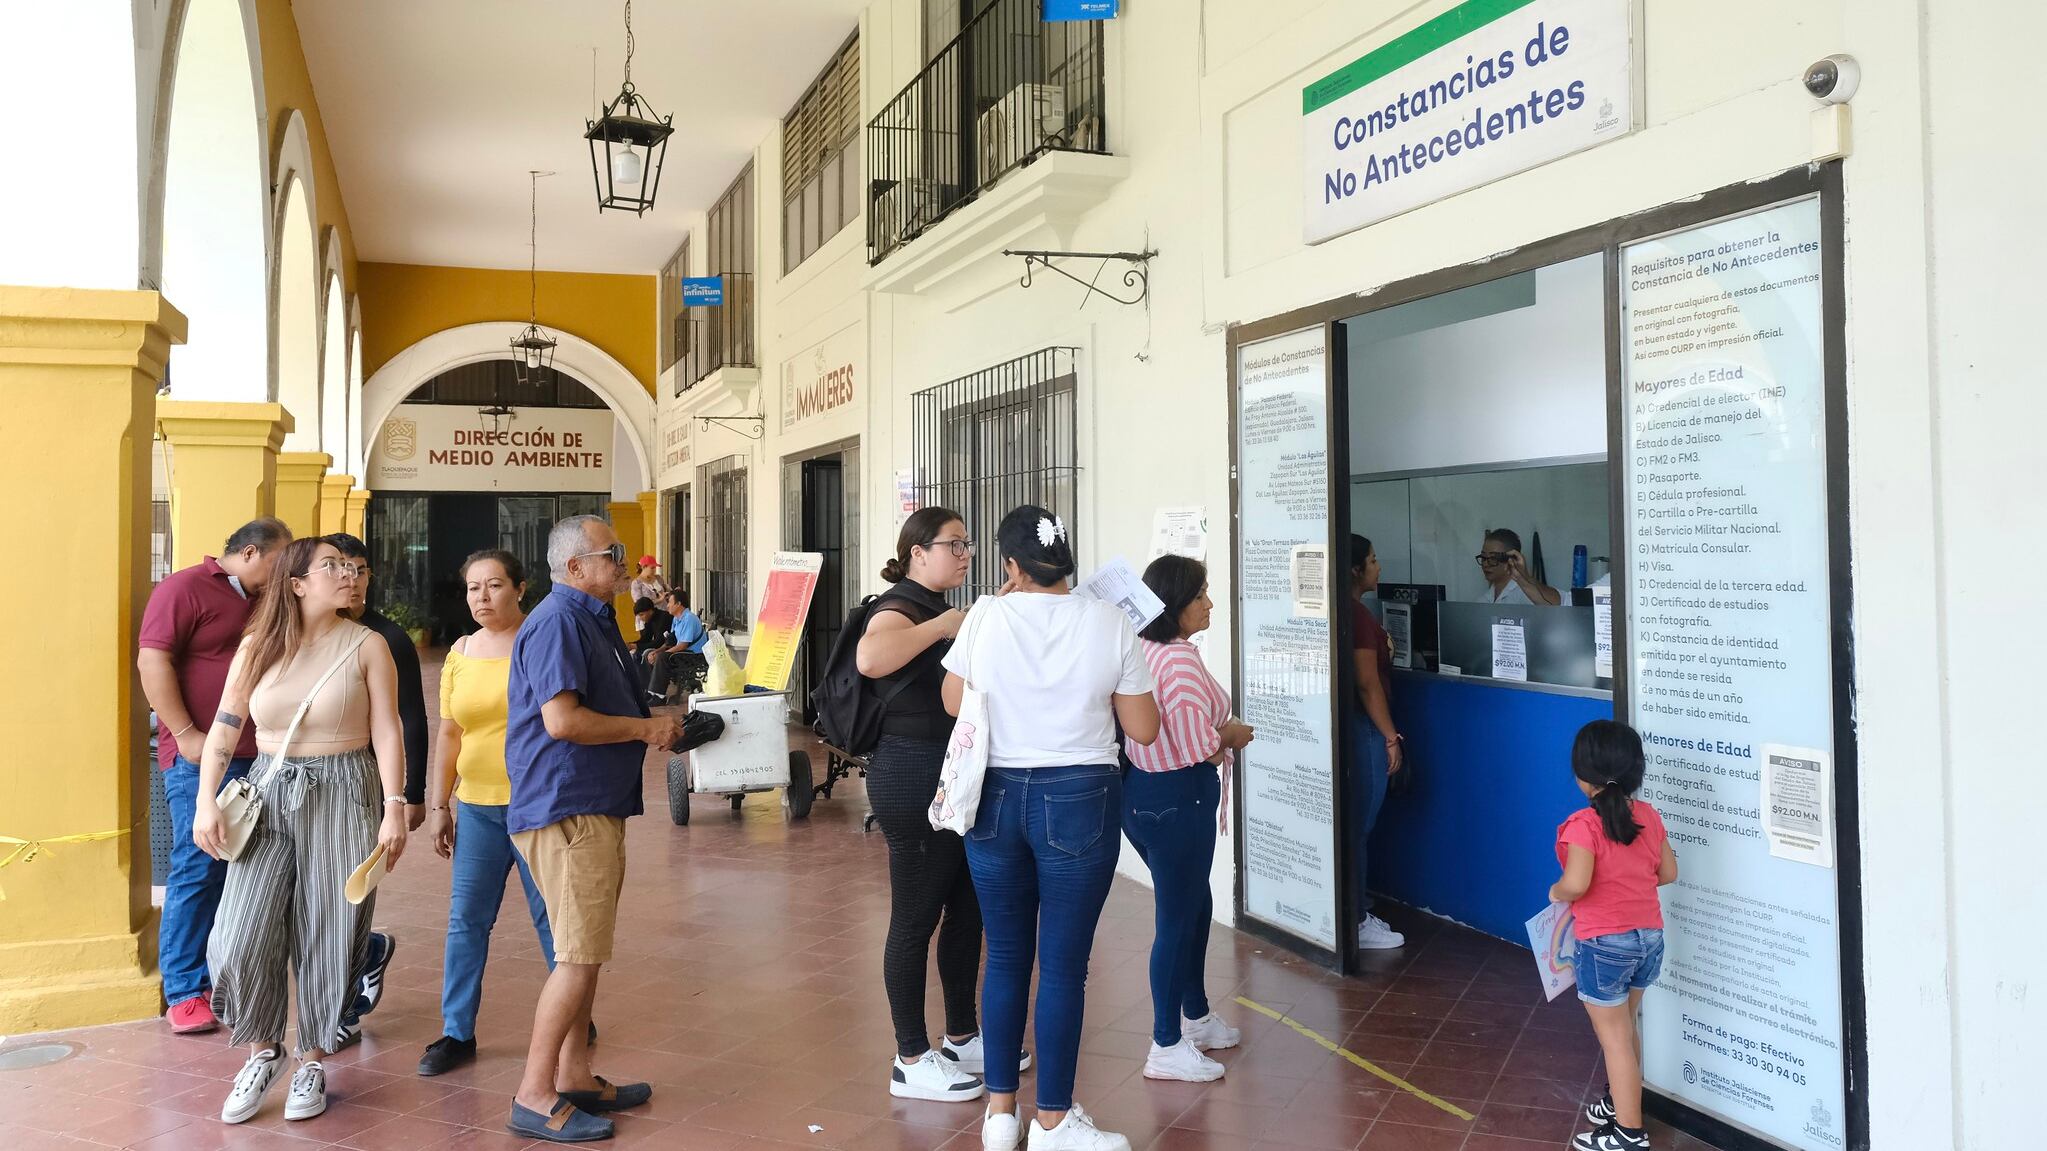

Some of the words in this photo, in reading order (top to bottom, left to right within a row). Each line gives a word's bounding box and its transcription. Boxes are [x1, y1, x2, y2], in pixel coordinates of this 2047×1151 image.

[1334, 50, 1514, 150] Constancias
[1525, 22, 1569, 67] de
[1593, 117, 1619, 132] Jalisco
[1325, 168, 1356, 204] No
[1364, 80, 1584, 190] Antecedentes
[1631, 256, 1684, 276] Requisitos
[1687, 250, 1714, 265] para
[1718, 235, 1764, 255] obtener
[1768, 231, 1780, 243] la
[1632, 269, 1693, 291] Constancia
[1696, 263, 1710, 277] de
[1713, 261, 1728, 273] No
[1731, 241, 1818, 269] Antecedentes
[684, 287, 720, 296] infinitum
[1647, 349, 1669, 358] como
[1671, 343, 1694, 354] CURP
[1696, 341, 1706, 350] en
[1708, 335, 1751, 351] impresión
[1753, 327, 1784, 340] oficial.
[1245, 357, 1270, 370] Módulos
[1272, 355, 1279, 364] de
[1281, 345, 1324, 363] Constancias
[1244, 376, 1252, 385] de
[1264, 365, 1309, 380] Antecedentes
[1635, 377, 1686, 395] Mayores
[1689, 373, 1705, 385] de
[1709, 366, 1743, 382] Edad
[1635, 405, 1646, 416] A)
[1648, 396, 1700, 413] Credencial
[1703, 394, 1715, 406] de
[1719, 391, 1756, 404] elector
[1759, 385, 1786, 400] (INE)
[1636, 422, 1646, 432] B)
[1648, 417, 1686, 431] Licencia
[1689, 414, 1701, 426] de
[1705, 411, 1742, 425] manejo
[1745, 408, 1761, 420] del
[454, 426, 554, 447] DIRECCIÓN
[563, 433, 582, 447] DE
[1636, 436, 1668, 449] Estado
[1671, 434, 1683, 446] de
[1686, 433, 1722, 445] Jalisco.
[429, 450, 494, 465] MEDIO
[504, 451, 602, 467] AMBIENTE
[1637, 456, 1647, 467] C)
[1650, 454, 1668, 465] FM2
[1679, 451, 1700, 463] FM3.
[1637, 474, 1647, 484] D)
[1650, 472, 1701, 484] Pasaporte.
[1638, 491, 1646, 502] E)
[1649, 488, 1683, 501] Cédula
[1686, 485, 1746, 500] profesional.
[1638, 509, 1646, 519] F)
[1649, 507, 1686, 519] Cartilla
[1689, 509, 1694, 517] o
[1696, 504, 1757, 517] Pre-cartilla
[1638, 526, 1652, 536] del
[1655, 525, 1692, 536] Servicio
[1695, 524, 1727, 535] Militar
[1731, 522, 1781, 534] Nacional.
[1639, 544, 1649, 555] G)
[1701, 543, 1751, 553] Consular.
[1639, 561, 1648, 572] H)
[1651, 561, 1674, 572] Visa.
[1640, 578, 1647, 589] I)
[1650, 579, 1701, 590] Credencial
[1704, 579, 1717, 590] de
[1719, 579, 1729, 591] la
[1732, 581, 1772, 591] tercera
[1776, 581, 1807, 592] edad.
[1640, 597, 1648, 607] J)
[1651, 597, 1706, 608] Certificado
[1709, 597, 1721, 609] de
[1724, 599, 1768, 610] estudios
[1640, 616, 1657, 624] con
[1598, 643, 1611, 651] $92.
[1640, 631, 1650, 642] K)
[1653, 632, 1709, 645] Constancia
[1711, 634, 1723, 646] de
[1726, 635, 1778, 650] identidad
[1641, 650, 1676, 661] emitida
[1679, 653, 1696, 664] por
[1699, 653, 1707, 664] el
[1710, 655, 1786, 670] ayuntamiento
[1641, 668, 1652, 677] en
[1655, 667, 1685, 680] donde
[1687, 672, 1697, 681] se
[1700, 672, 1732, 684] resida
[1642, 684, 1653, 694] de
[1655, 687, 1667, 696] no
[1670, 688, 1690, 698] más
[1693, 689, 1705, 700] de
[1707, 692, 1720, 701] un
[1723, 692, 1743, 704] año
[1642, 702, 1653, 712] de
[1656, 702, 1683, 716] haber
[1687, 706, 1706, 718] sido
[1709, 710, 1751, 724] emitida.
[1642, 731, 1693, 750] Menores
[1697, 738, 1712, 752] de
[1717, 741, 1751, 758] Edad
[1655, 754, 1711, 773] Certificado
[1714, 763, 1726, 776] de
[1728, 766, 1761, 781] estudi
[1780, 758, 1802, 767] AVISO
[1643, 772, 1660, 782] con
[1643, 787, 1653, 799] B)
[1656, 790, 1709, 810] Credencial
[1712, 799, 1724, 812] de
[1727, 805, 1760, 820] estudi
[1772, 805, 1802, 817] $92.00
[1804, 812, 1820, 822] M.N.
[1698, 814, 1710, 828] de
[1713, 820, 1761, 839] conducir.
[1682, 1014, 1713, 1033] Forma
[1716, 1026, 1727, 1039] de
[1730, 1031, 1758, 1050] pago:
[1761, 1042, 1805, 1067] Efectivo
[1682, 1031, 1730, 1057] Informes:
[1732, 1049, 1743, 1062] 33
[1746, 1054, 1758, 1067] 30
[1761, 1060, 1773, 1073] 30
[1776, 1066, 1789, 1079] 94
[1793, 1072, 1806, 1086] 05
[1700, 1068, 1729, 1085] Instituto
[1732, 1080, 1771, 1101] Jalisciense
[1700, 1076, 1710, 1084] de
[1711, 1079, 1740, 1097] Ciencias
[1742, 1093, 1774, 1112] Forenses
[1803, 1122, 1841, 1146] Jalisco
